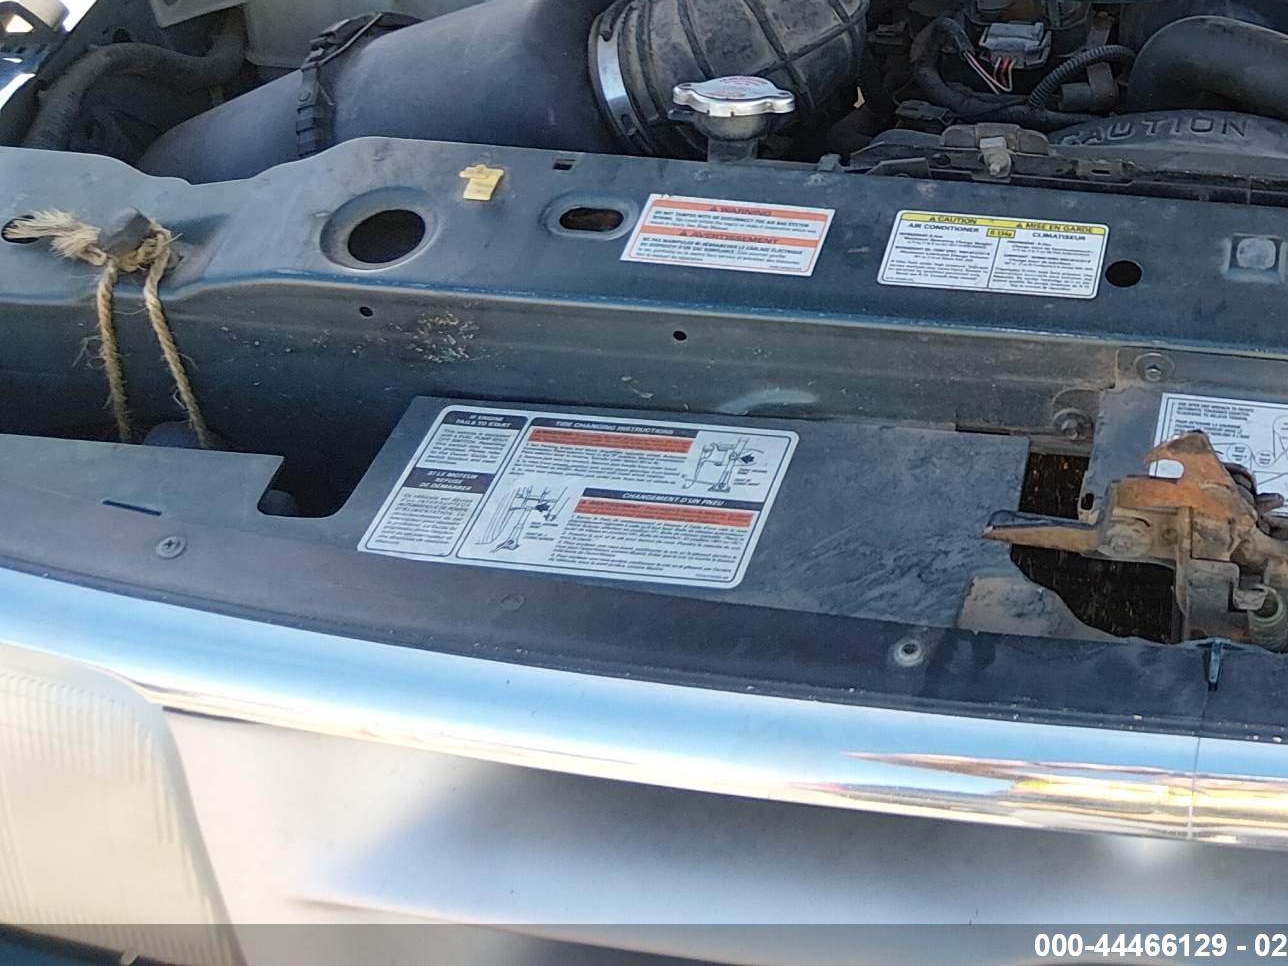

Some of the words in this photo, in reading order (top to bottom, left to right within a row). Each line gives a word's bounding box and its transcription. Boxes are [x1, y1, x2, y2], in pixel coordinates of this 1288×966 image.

[1061, 118, 1249, 148] CAUTION
[721, 206, 771, 216] WARNING
[937, 216, 977, 225] CAUTION
[924, 223, 979, 233] CONDITIONER
[1026, 222, 1046, 230] MISE
[1063, 225, 1093, 234] GARDE
[689, 230, 779, 245] AVERTISSEMENT
[1032, 232, 1087, 242] CLIMATISEUR
